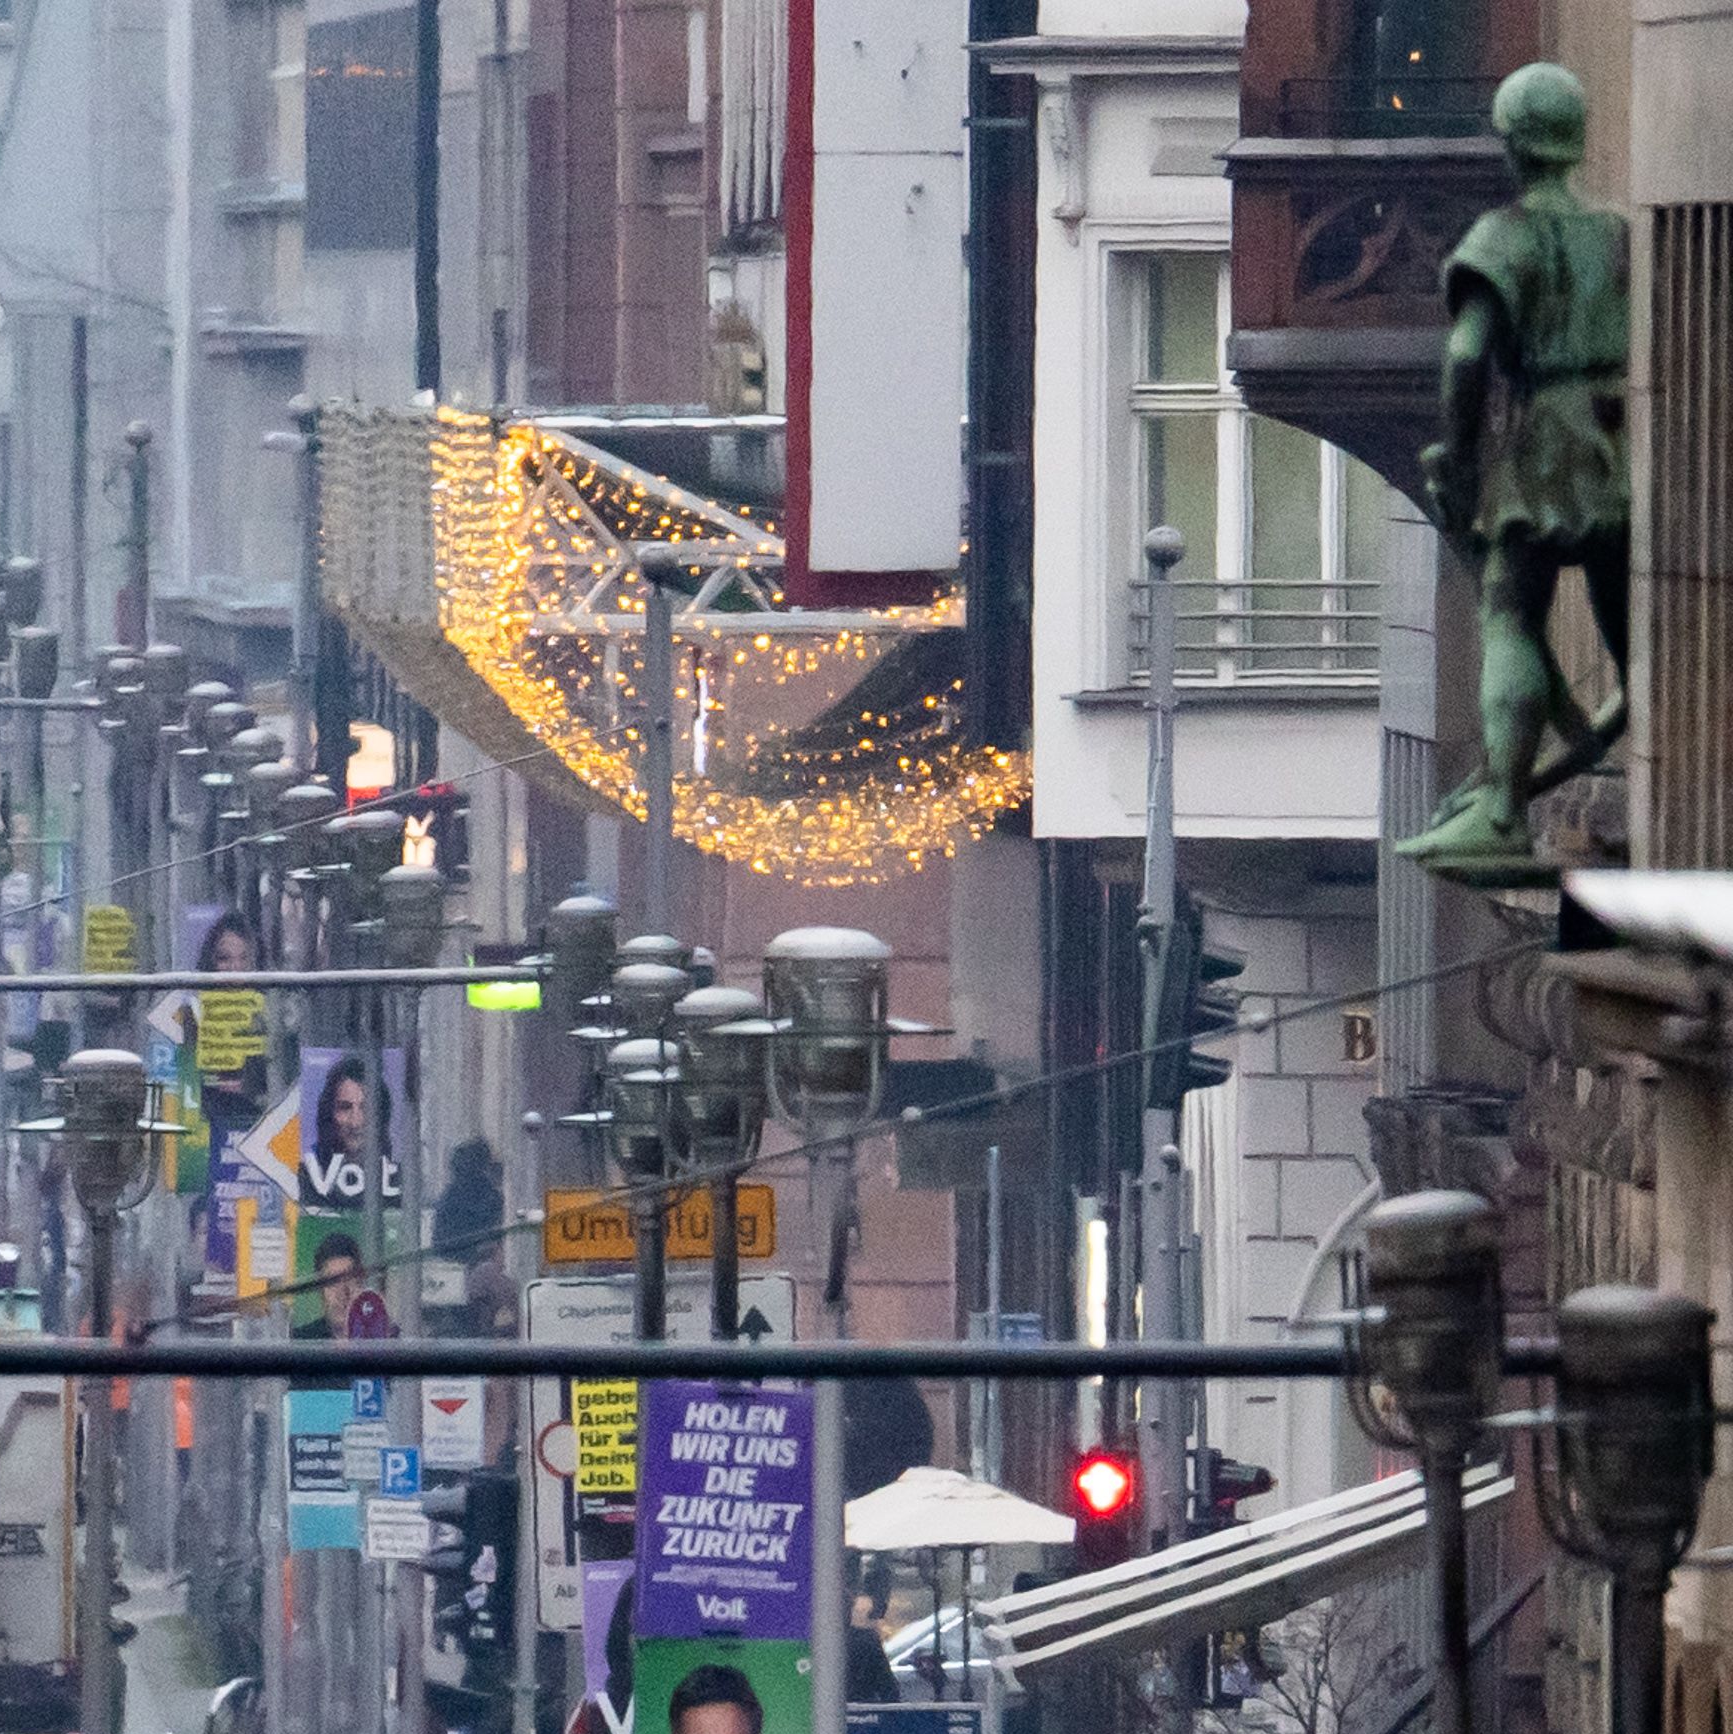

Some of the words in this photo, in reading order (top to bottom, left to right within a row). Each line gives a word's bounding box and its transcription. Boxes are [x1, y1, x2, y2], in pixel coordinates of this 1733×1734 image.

[304, 1153, 402, 1197] Vot
[684, 1402, 788, 1433] HOLEN
[670, 1432, 731, 1463] WIR
[733, 1436, 799, 1468] UNS
[386, 1452, 408, 1487] P
[705, 1466, 758, 1497] DIE
[656, 1495, 804, 1532] ZUKUNFT
[662, 1527, 790, 1562] ZURÜCK
[696, 1594, 749, 1621] Volt
